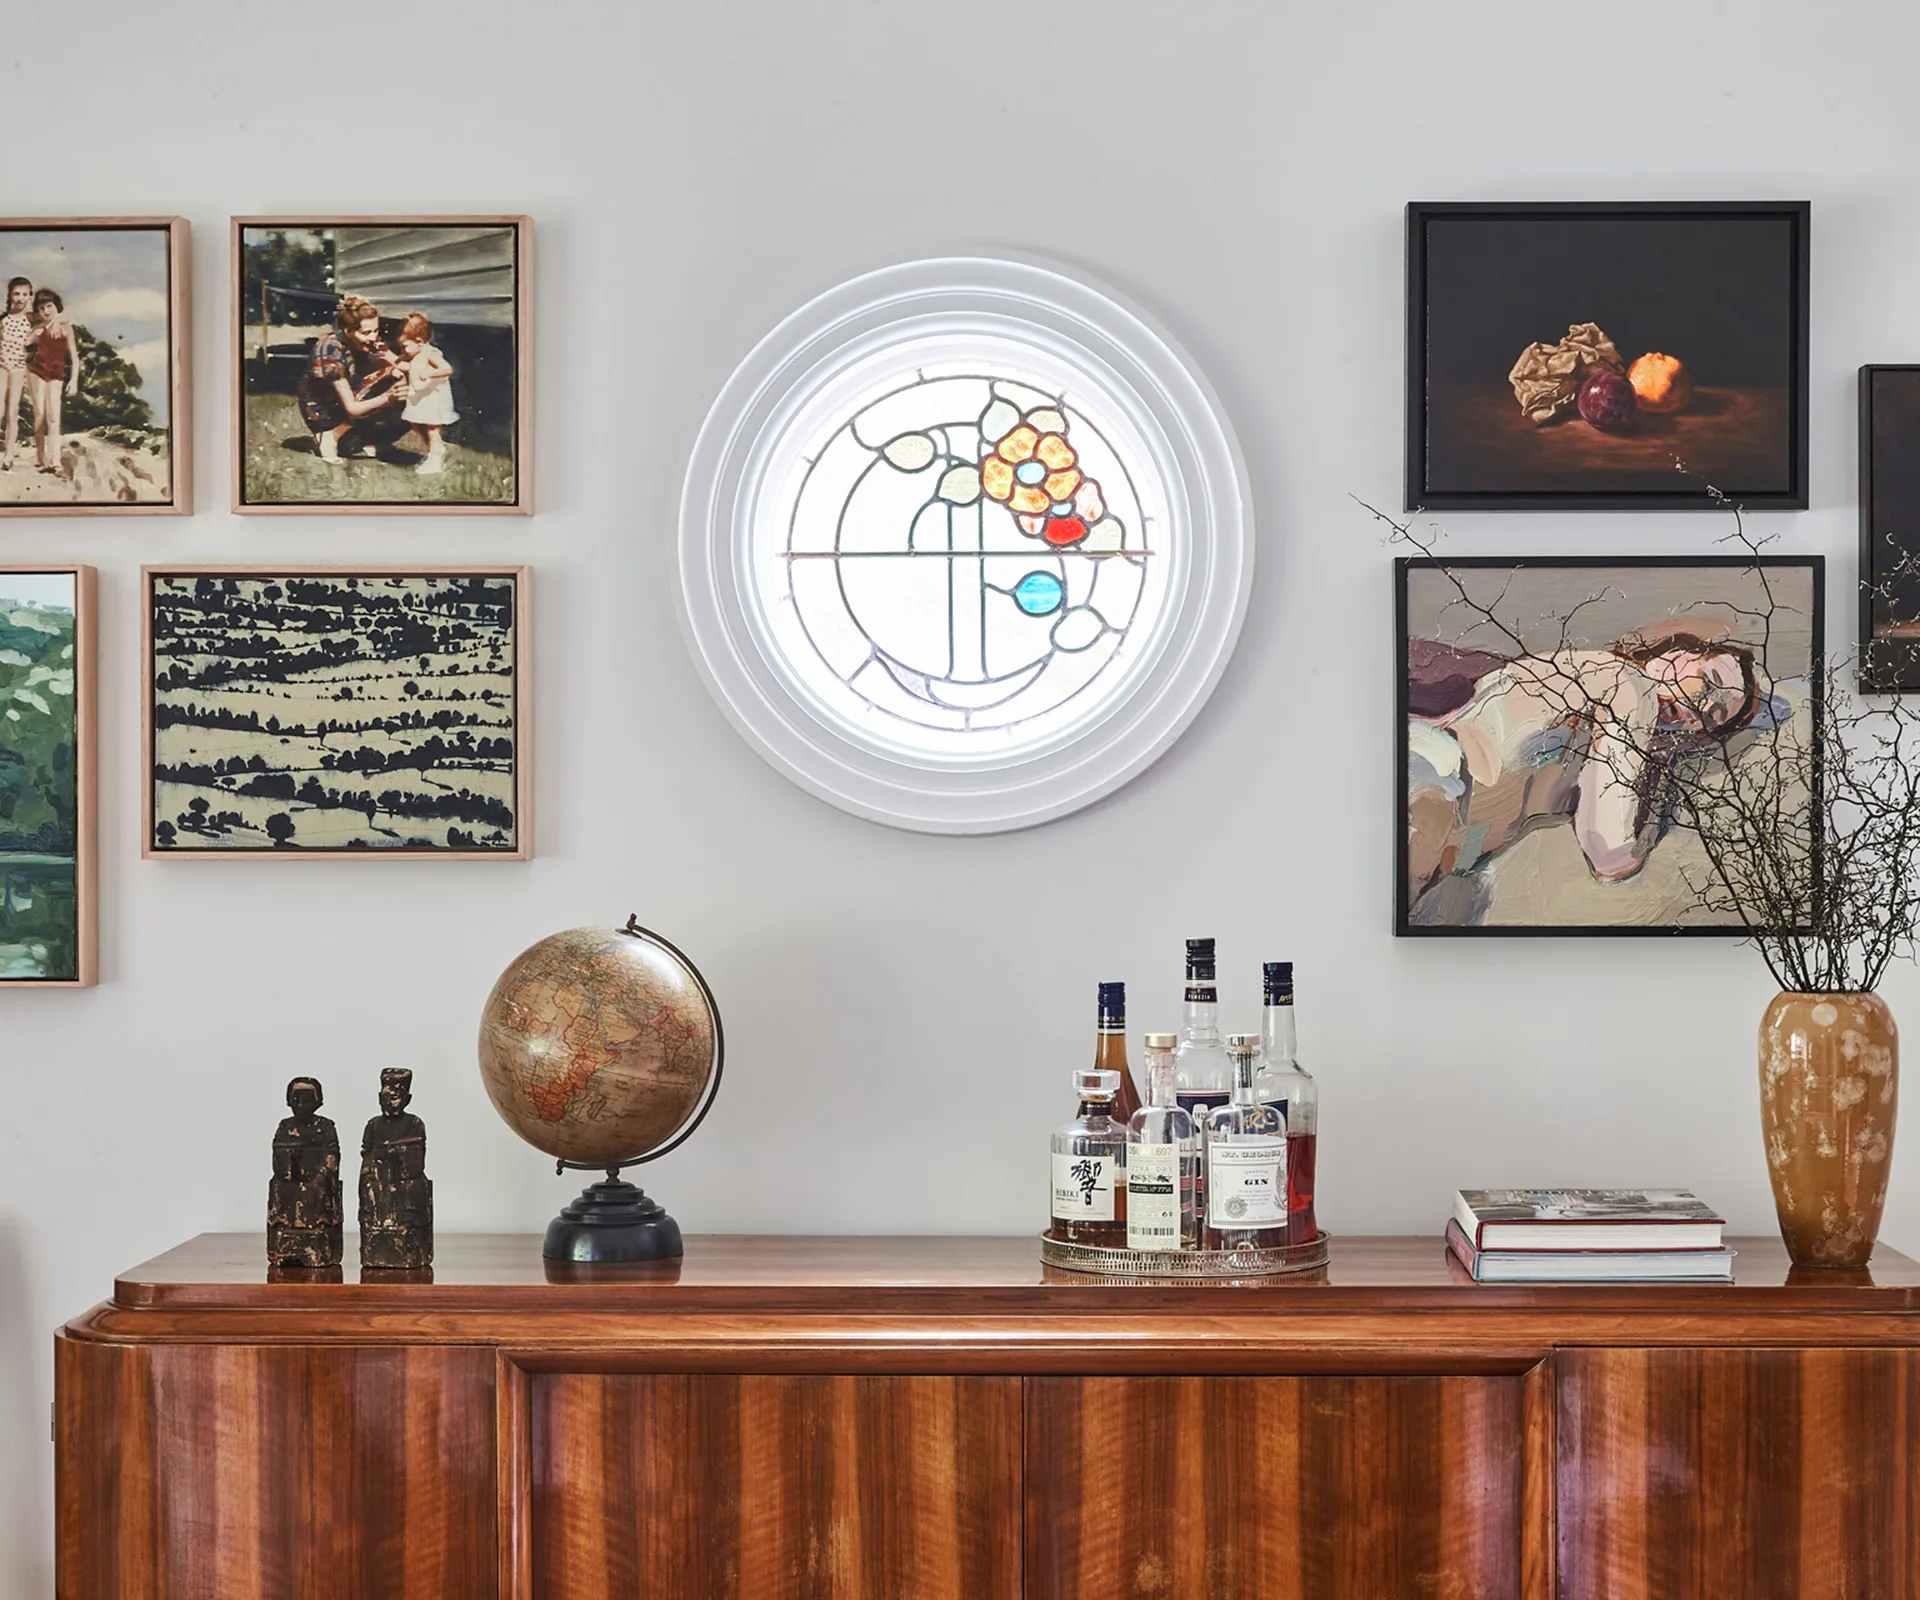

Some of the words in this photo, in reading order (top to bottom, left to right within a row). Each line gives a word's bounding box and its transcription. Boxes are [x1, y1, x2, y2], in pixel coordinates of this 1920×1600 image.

[1156, 1165, 1173, 1174] DRY
[1244, 1178, 1269, 1186] GIN
[1055, 1188, 1079, 1198] HIBIKI
